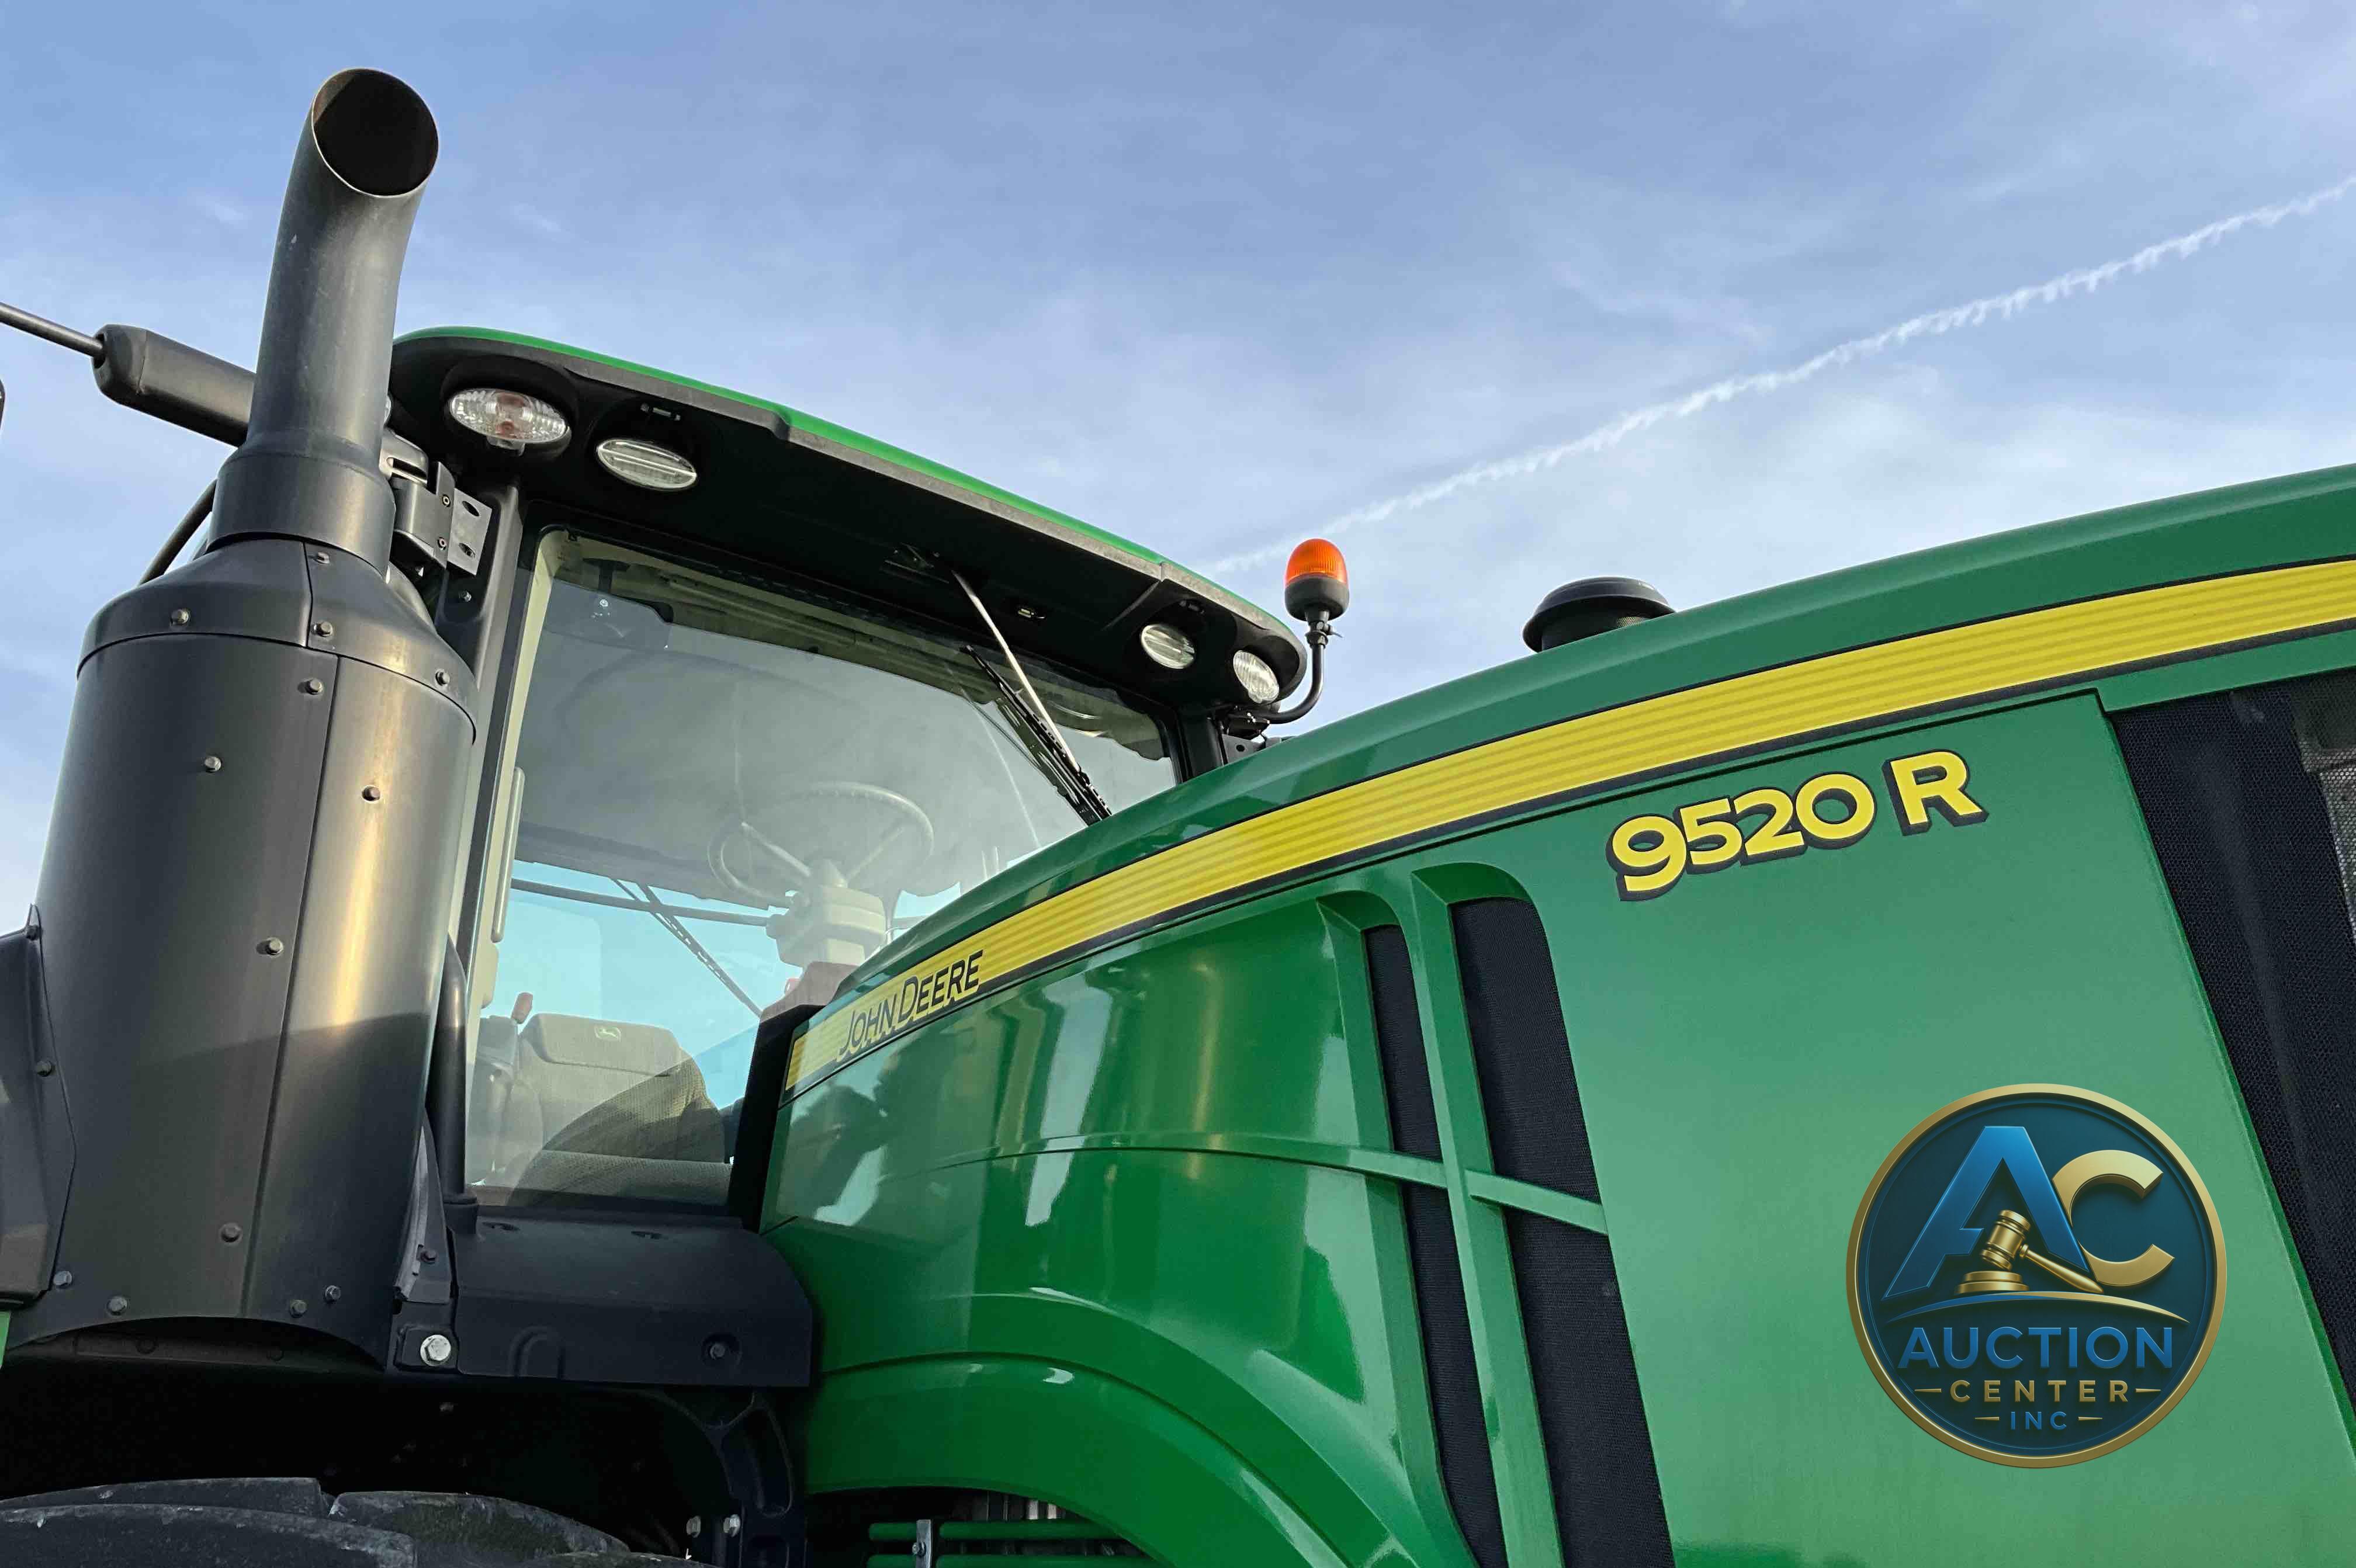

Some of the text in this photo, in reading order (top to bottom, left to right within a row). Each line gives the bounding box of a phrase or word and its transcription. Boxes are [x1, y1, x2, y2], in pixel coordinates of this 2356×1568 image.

[1606, 749, 1989, 901] 9520 R
[839, 949, 983, 1055] JOHN DEERE
